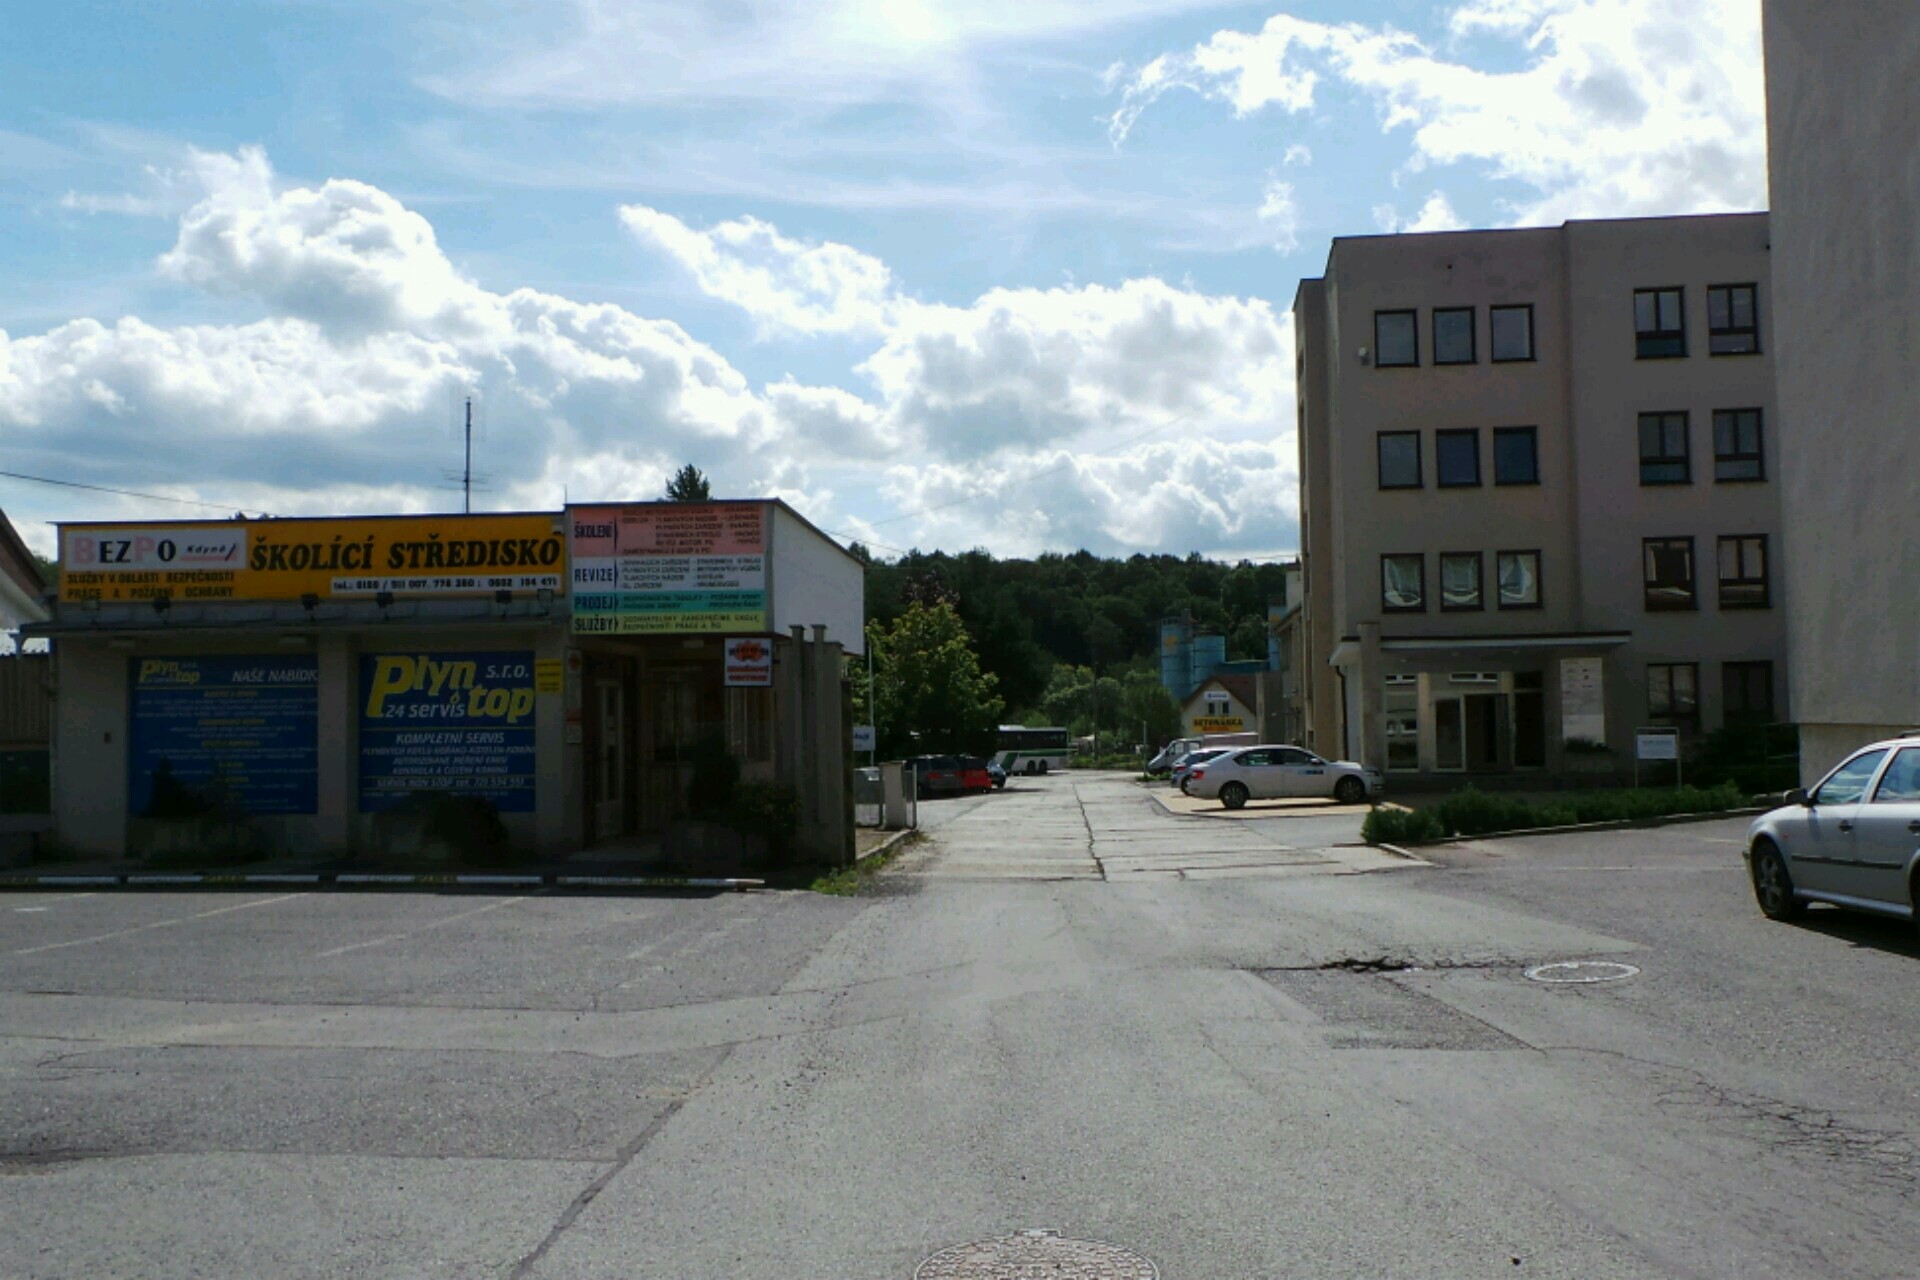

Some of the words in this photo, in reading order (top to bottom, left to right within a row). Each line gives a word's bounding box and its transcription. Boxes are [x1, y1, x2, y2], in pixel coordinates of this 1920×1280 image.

[574, 521, 613, 539] ŠKOLENÍ
[73, 535, 177, 564] BEZPO
[250, 536, 375, 571] ŠKOLÍCÍ
[387, 533, 562, 570] STŘEDISKO
[67, 570, 105, 584] SLUŽBY
[108, 573, 115, 583] V
[118, 572, 160, 584] OBLASTI
[165, 569, 235, 582] BEZPEČNOSTI
[574, 568, 613, 583] REVIZE
[114, 588, 120, 598] A
[185, 586, 234, 598] OCHRANY
[574, 595, 614, 611] PRODEJ
[574, 613, 613, 632] SLUŽBY
[232, 666, 266, 682] NAŠE
[485, 664, 530, 680] s.r.o.
[364, 655, 477, 718] Plyn
[385, 705, 406, 719] 24
[408, 701, 466, 719] servis
[466, 683, 535, 724] top
[395, 730, 464, 745] KOMPLETNÍ
[465, 731, 505, 744] SERVIS
